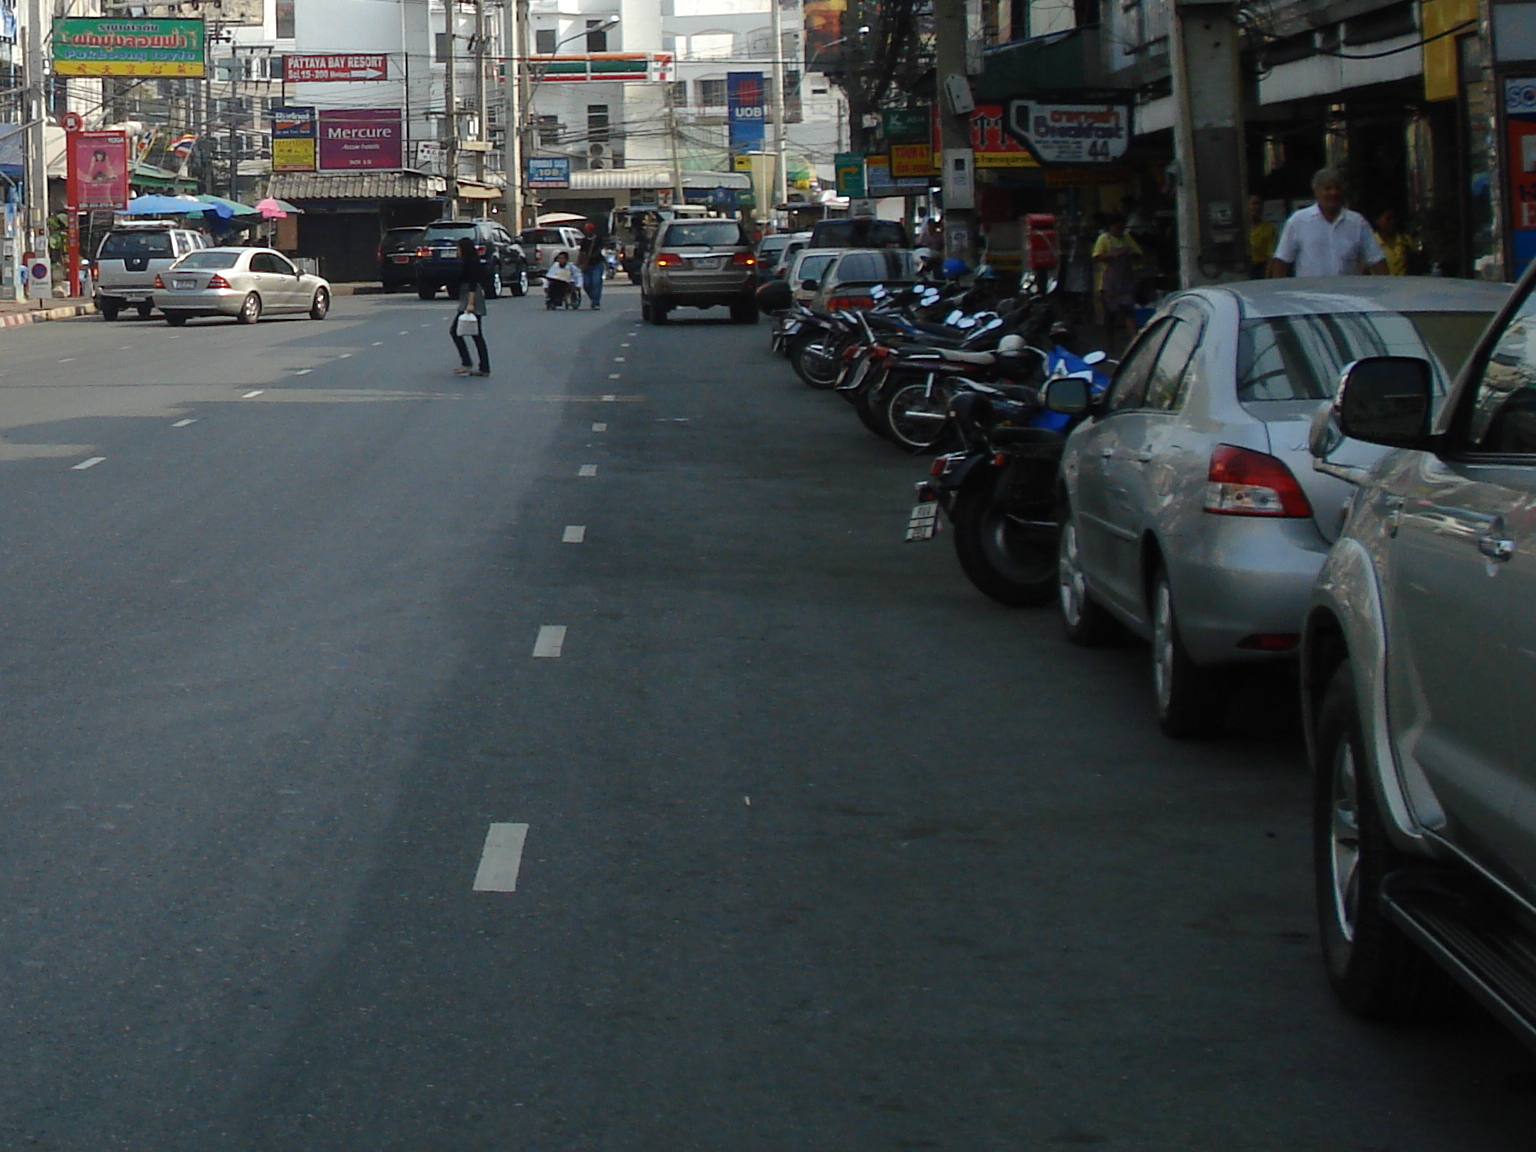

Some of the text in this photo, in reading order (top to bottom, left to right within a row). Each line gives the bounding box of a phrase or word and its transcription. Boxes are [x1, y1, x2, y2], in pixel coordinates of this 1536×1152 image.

[72, 29, 187, 51] ผักบุ้งลอยฟ้า
[288, 56, 383, 68] PATTAYA BAY RESORT
[735, 107, 762, 122] UOB
[328, 127, 392, 139] Mercure
